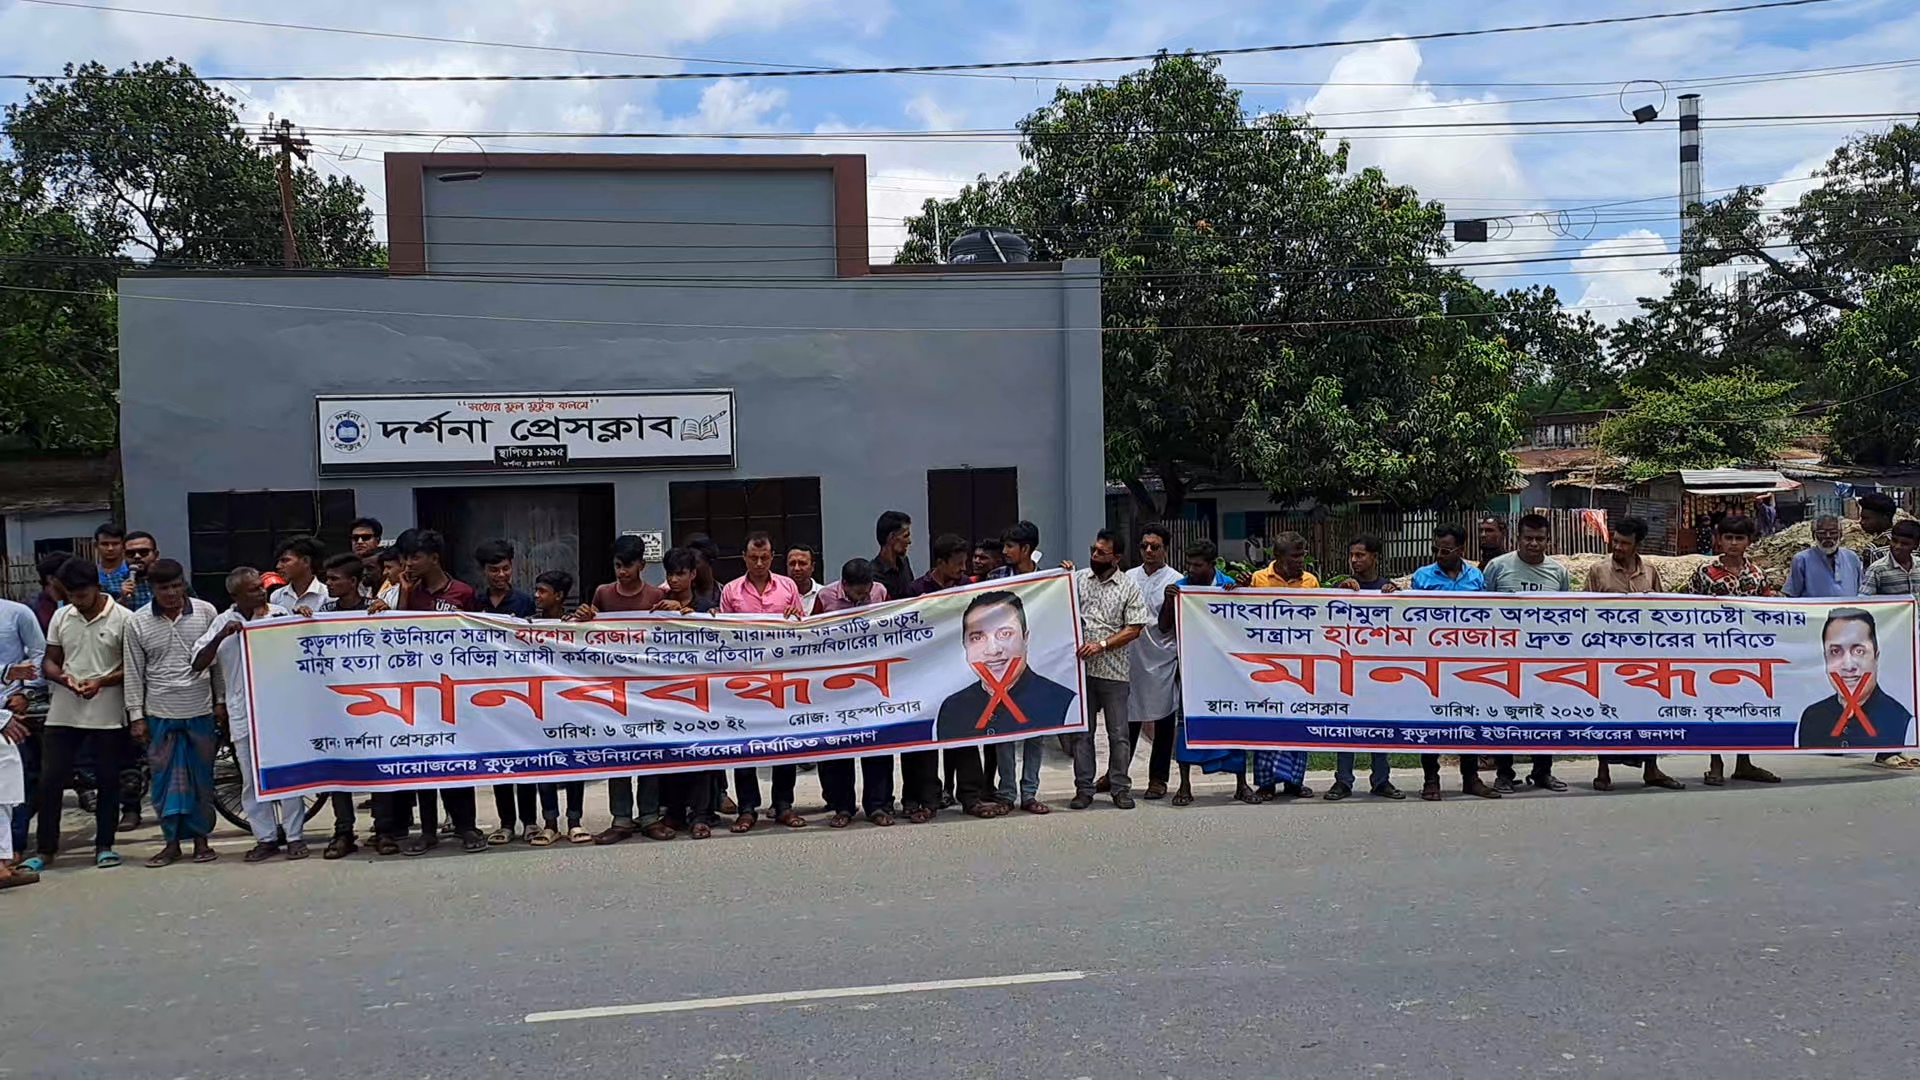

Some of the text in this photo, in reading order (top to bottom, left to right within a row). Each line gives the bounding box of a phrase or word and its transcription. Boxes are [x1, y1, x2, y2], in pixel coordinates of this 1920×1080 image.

[504, 401, 524, 413] ফুল
[376, 411, 680, 444] দর্শনা প্রেসক্লাব
[537, 448, 564, 457] ১৯৯৫
[1208, 599, 1807, 627] সাংবাদিক শিমুল রেজাকে অপহরণ করে হত্যাচেষ্টা করায়
[380, 626, 454, 648] ইউনিয়নে
[461, 629, 507, 643] সন্ত্রাস
[515, 628, 574, 645] হাশেম
[585, 628, 646, 645] রেজার
[653, 627, 726, 648] চাঁদাবাজি,
[1245, 624, 1777, 650] সন্ত্রাস হাশেম রেজার দ্রুত গ্রেফতারের দাবিতে
[296, 657, 335, 676] মানুষ
[341, 654, 381, 672] হত্যা
[388, 649, 423, 669] চেষ্টা
[430, 653, 443, 666] ও
[450, 645, 497, 667] বিভিন্ন
[504, 645, 554, 665] সন্ত্রাসী
[645, 647, 699, 666] বিরুদ্ধে
[704, 645, 767, 664] প্রতিবাদ
[771, 647, 784, 659] ও
[790, 634, 878, 656] ন্যায়বিচারের
[883, 627, 934, 645] দাবিতে
[1228, 649, 1791, 699] মানববন্ধন
[327, 656, 911, 725] মানববন্ধন
[789, 700, 921, 727] রোজ: বৃহস্পতিবার
[1205, 697, 1350, 716] স্থান: দর্শনা প্রেসক্লাব
[1430, 701, 1618, 720] তারিখ: ৬ জুলাই ২০২৩ ইং
[1657, 702, 1781, 722] রোজ: বৃহস্পতিবার
[542, 715, 747, 740] তারিখ: ৬ জুলাই ২০২৩ ইং
[1307, 724, 1395, 739] আয়োজনেঃ
[1481, 725, 1563, 741] ইউনিয়নের
[1567, 725, 1632, 741] সর্বস্তরের
[1637, 728, 1687, 741] জনগণ
[310, 731, 456, 752] স্থান: দর্শনা প্রেসক্লাব
[377, 759, 476, 775] আয়োজনেঃ
[574, 747, 663, 763] ইউনিয়নের
[670, 741, 743, 759] সর্বস্তরের
[749, 735, 820, 754] নির্যাতিত
[824, 730, 878, 746] জনগণ
